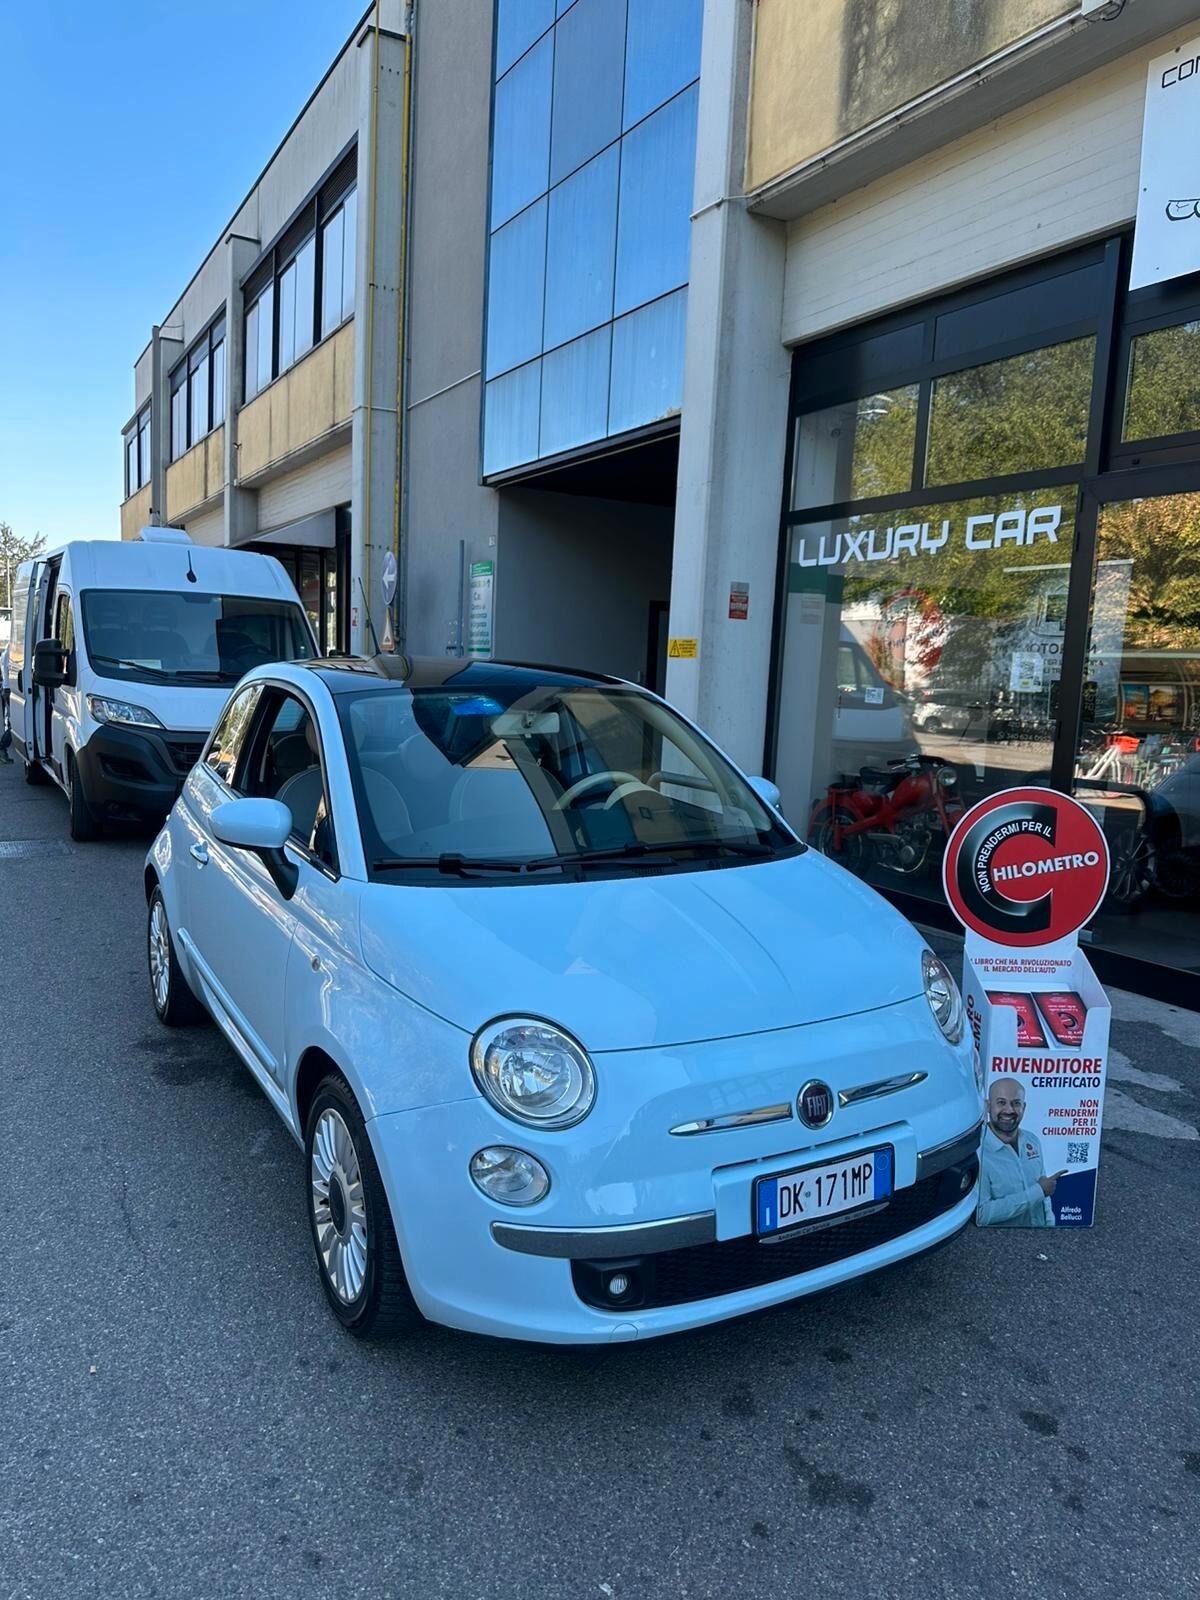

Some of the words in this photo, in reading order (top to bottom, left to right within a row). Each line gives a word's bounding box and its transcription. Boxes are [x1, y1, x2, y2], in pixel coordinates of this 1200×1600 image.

[799, 520, 950, 568] LUXURY
[965, 505, 1062, 551] CAR
[1021, 821, 1043, 833] PER
[1042, 825, 1052, 838] IL
[977, 822, 1020, 869] PRENDERMI
[977, 870, 992, 893] NON
[1020, 959, 1072, 967] RIVOLUZIONATO
[1023, 966, 1056, 974] DELL'AUTO
[991, 1056, 1102, 1074] RIVENDITORE
[1031, 1076, 1101, 1088] CERTIFICATO
[806, 1094, 827, 1118] FIAT
[1079, 1099, 1099, 1108] NON
[1048, 1108, 1098, 1117] PRENDERMI
[1072, 1118, 1089, 1127] PER
[1090, 1118, 1098, 1127] IL
[1042, 1127, 1097, 1136] CHILOMETRO
[779, 1180, 805, 1218] DK
[815, 1162, 873, 1208] 171MP
[1060, 1213, 1082, 1221] Bellucci
